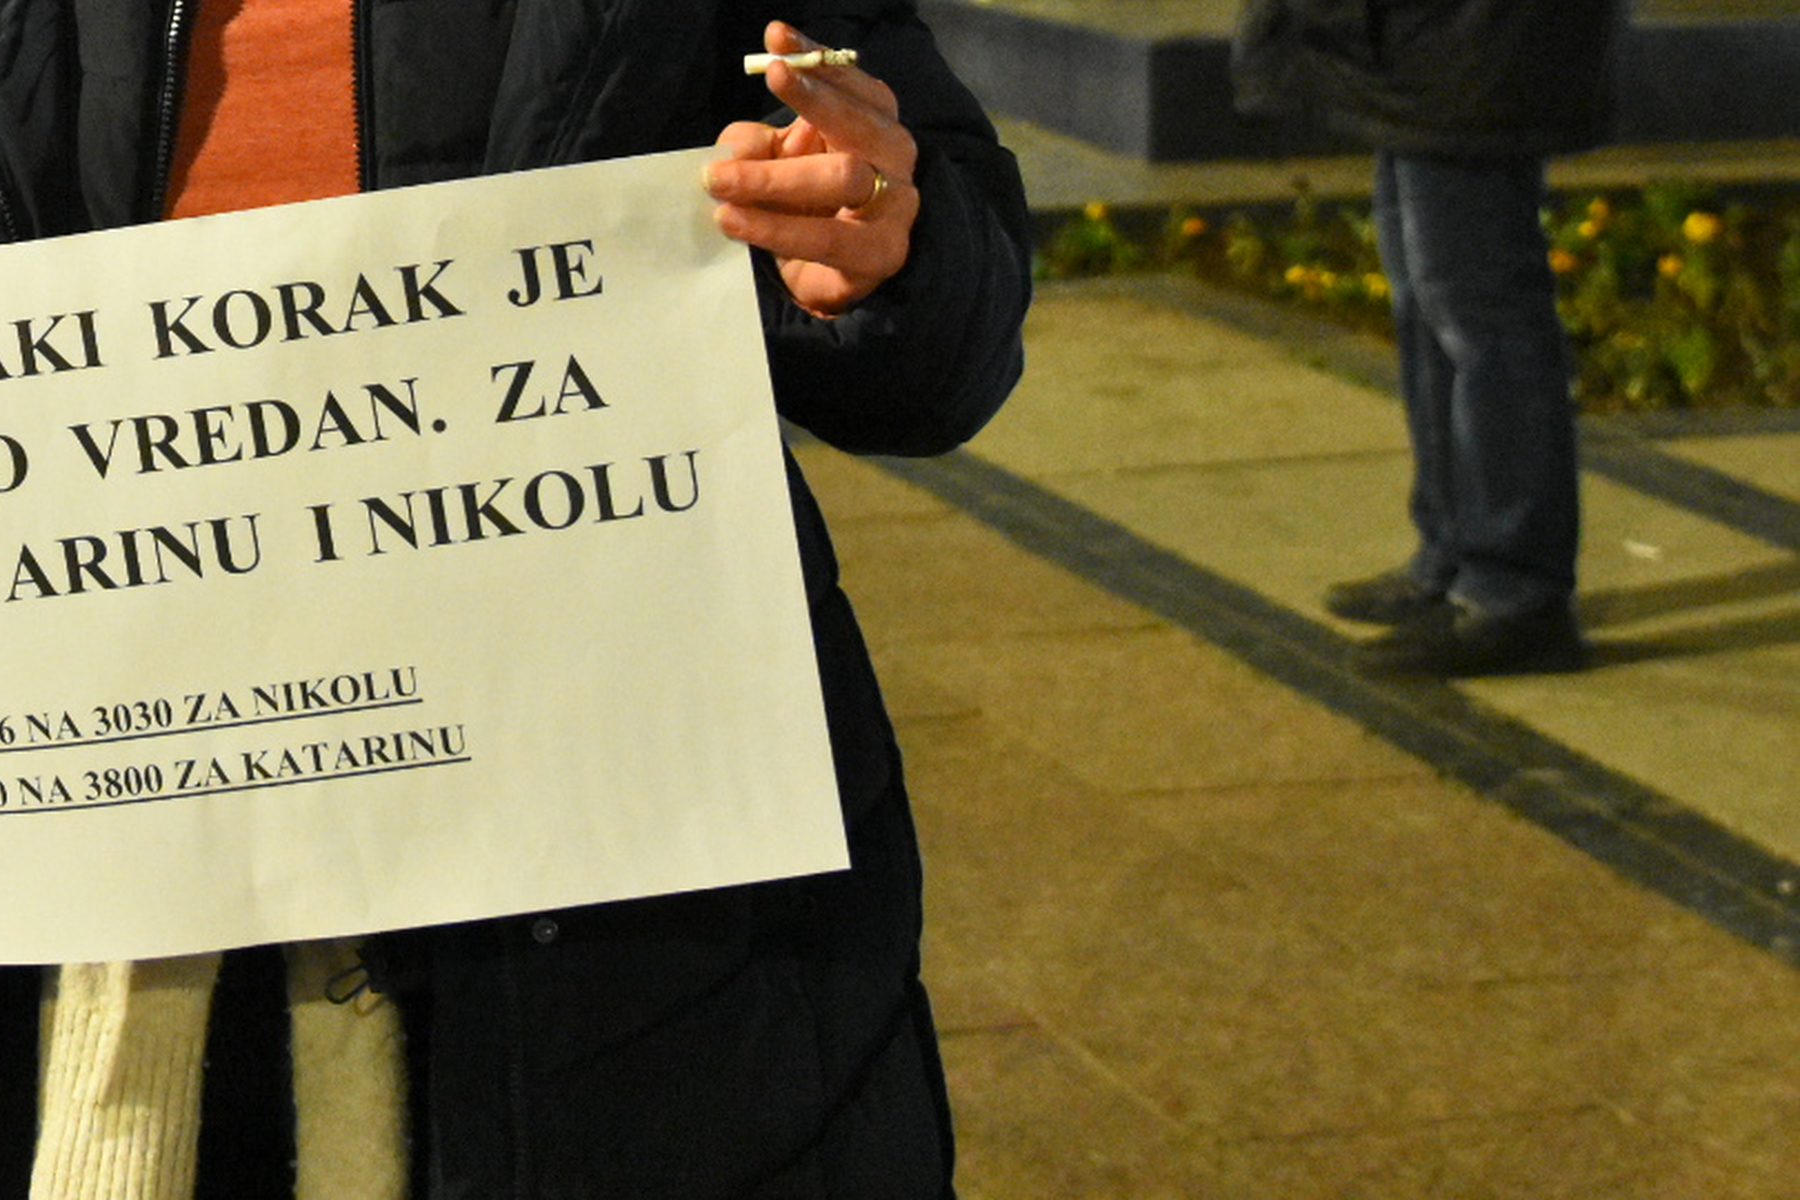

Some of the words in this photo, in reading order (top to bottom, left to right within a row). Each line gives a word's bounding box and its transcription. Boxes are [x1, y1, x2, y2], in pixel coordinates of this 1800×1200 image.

[148, 259, 467, 360] KORAK
[507, 238, 603, 308] JE
[67, 377, 447, 480] VREDAN.
[490, 354, 610, 424] ZA
[306, 502, 341, 564] I
[356, 450, 704, 557] NIKOLU
[25, 710, 83, 742] NA
[93, 699, 173, 737] 3030
[184, 691, 242, 725] ZA
[251, 666, 418, 714] NIKOLU
[17, 775, 73, 805] NA
[83, 764, 163, 801] 3800
[176, 757, 231, 791] ZA
[240, 724, 466, 783] KATARINU
